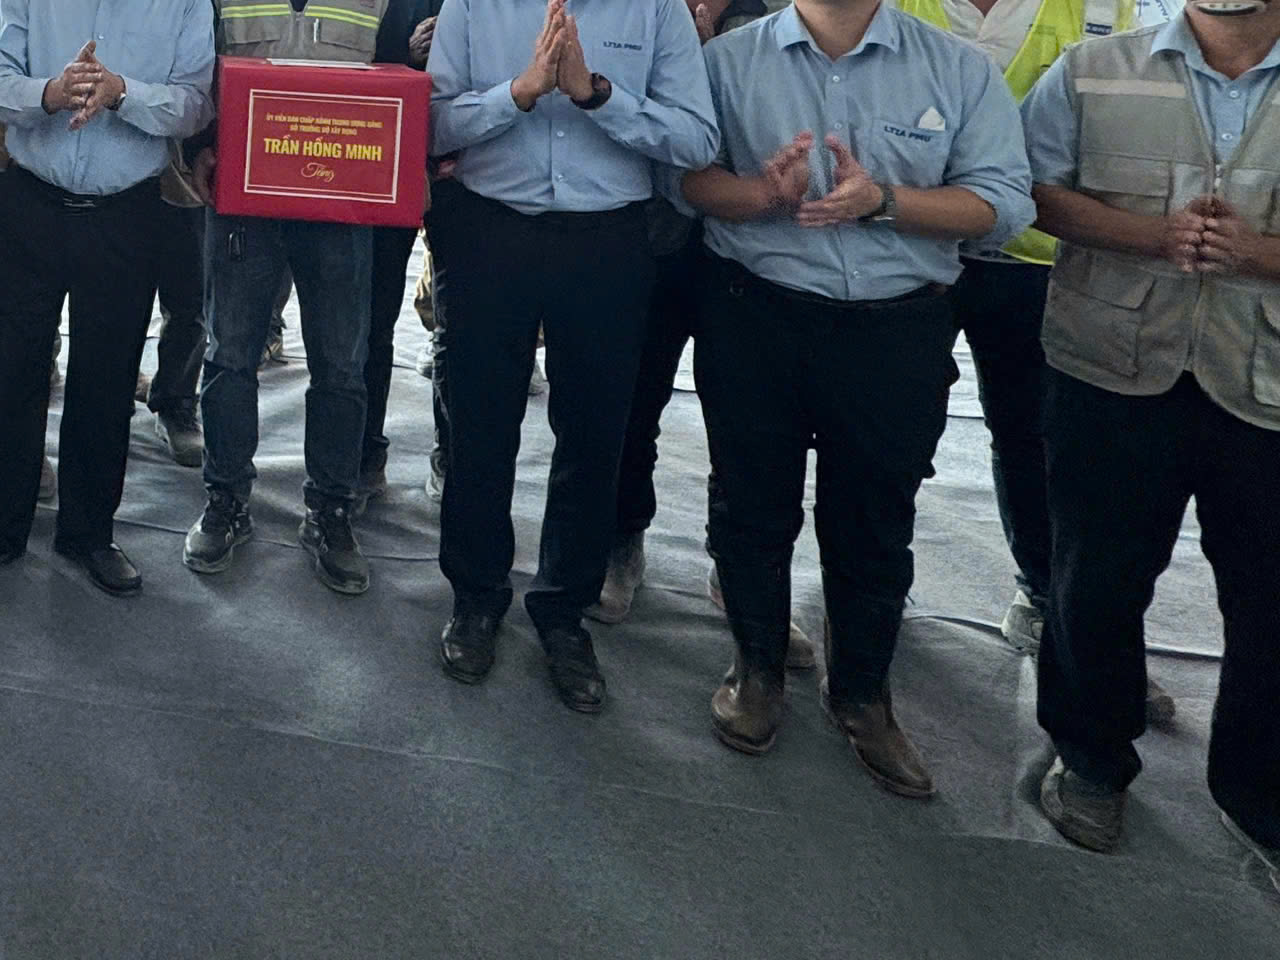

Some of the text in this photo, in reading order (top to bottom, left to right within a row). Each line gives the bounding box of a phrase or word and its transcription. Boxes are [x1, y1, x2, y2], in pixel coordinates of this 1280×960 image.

[264, 135, 382, 161] TRẦN HỒNG MINH
